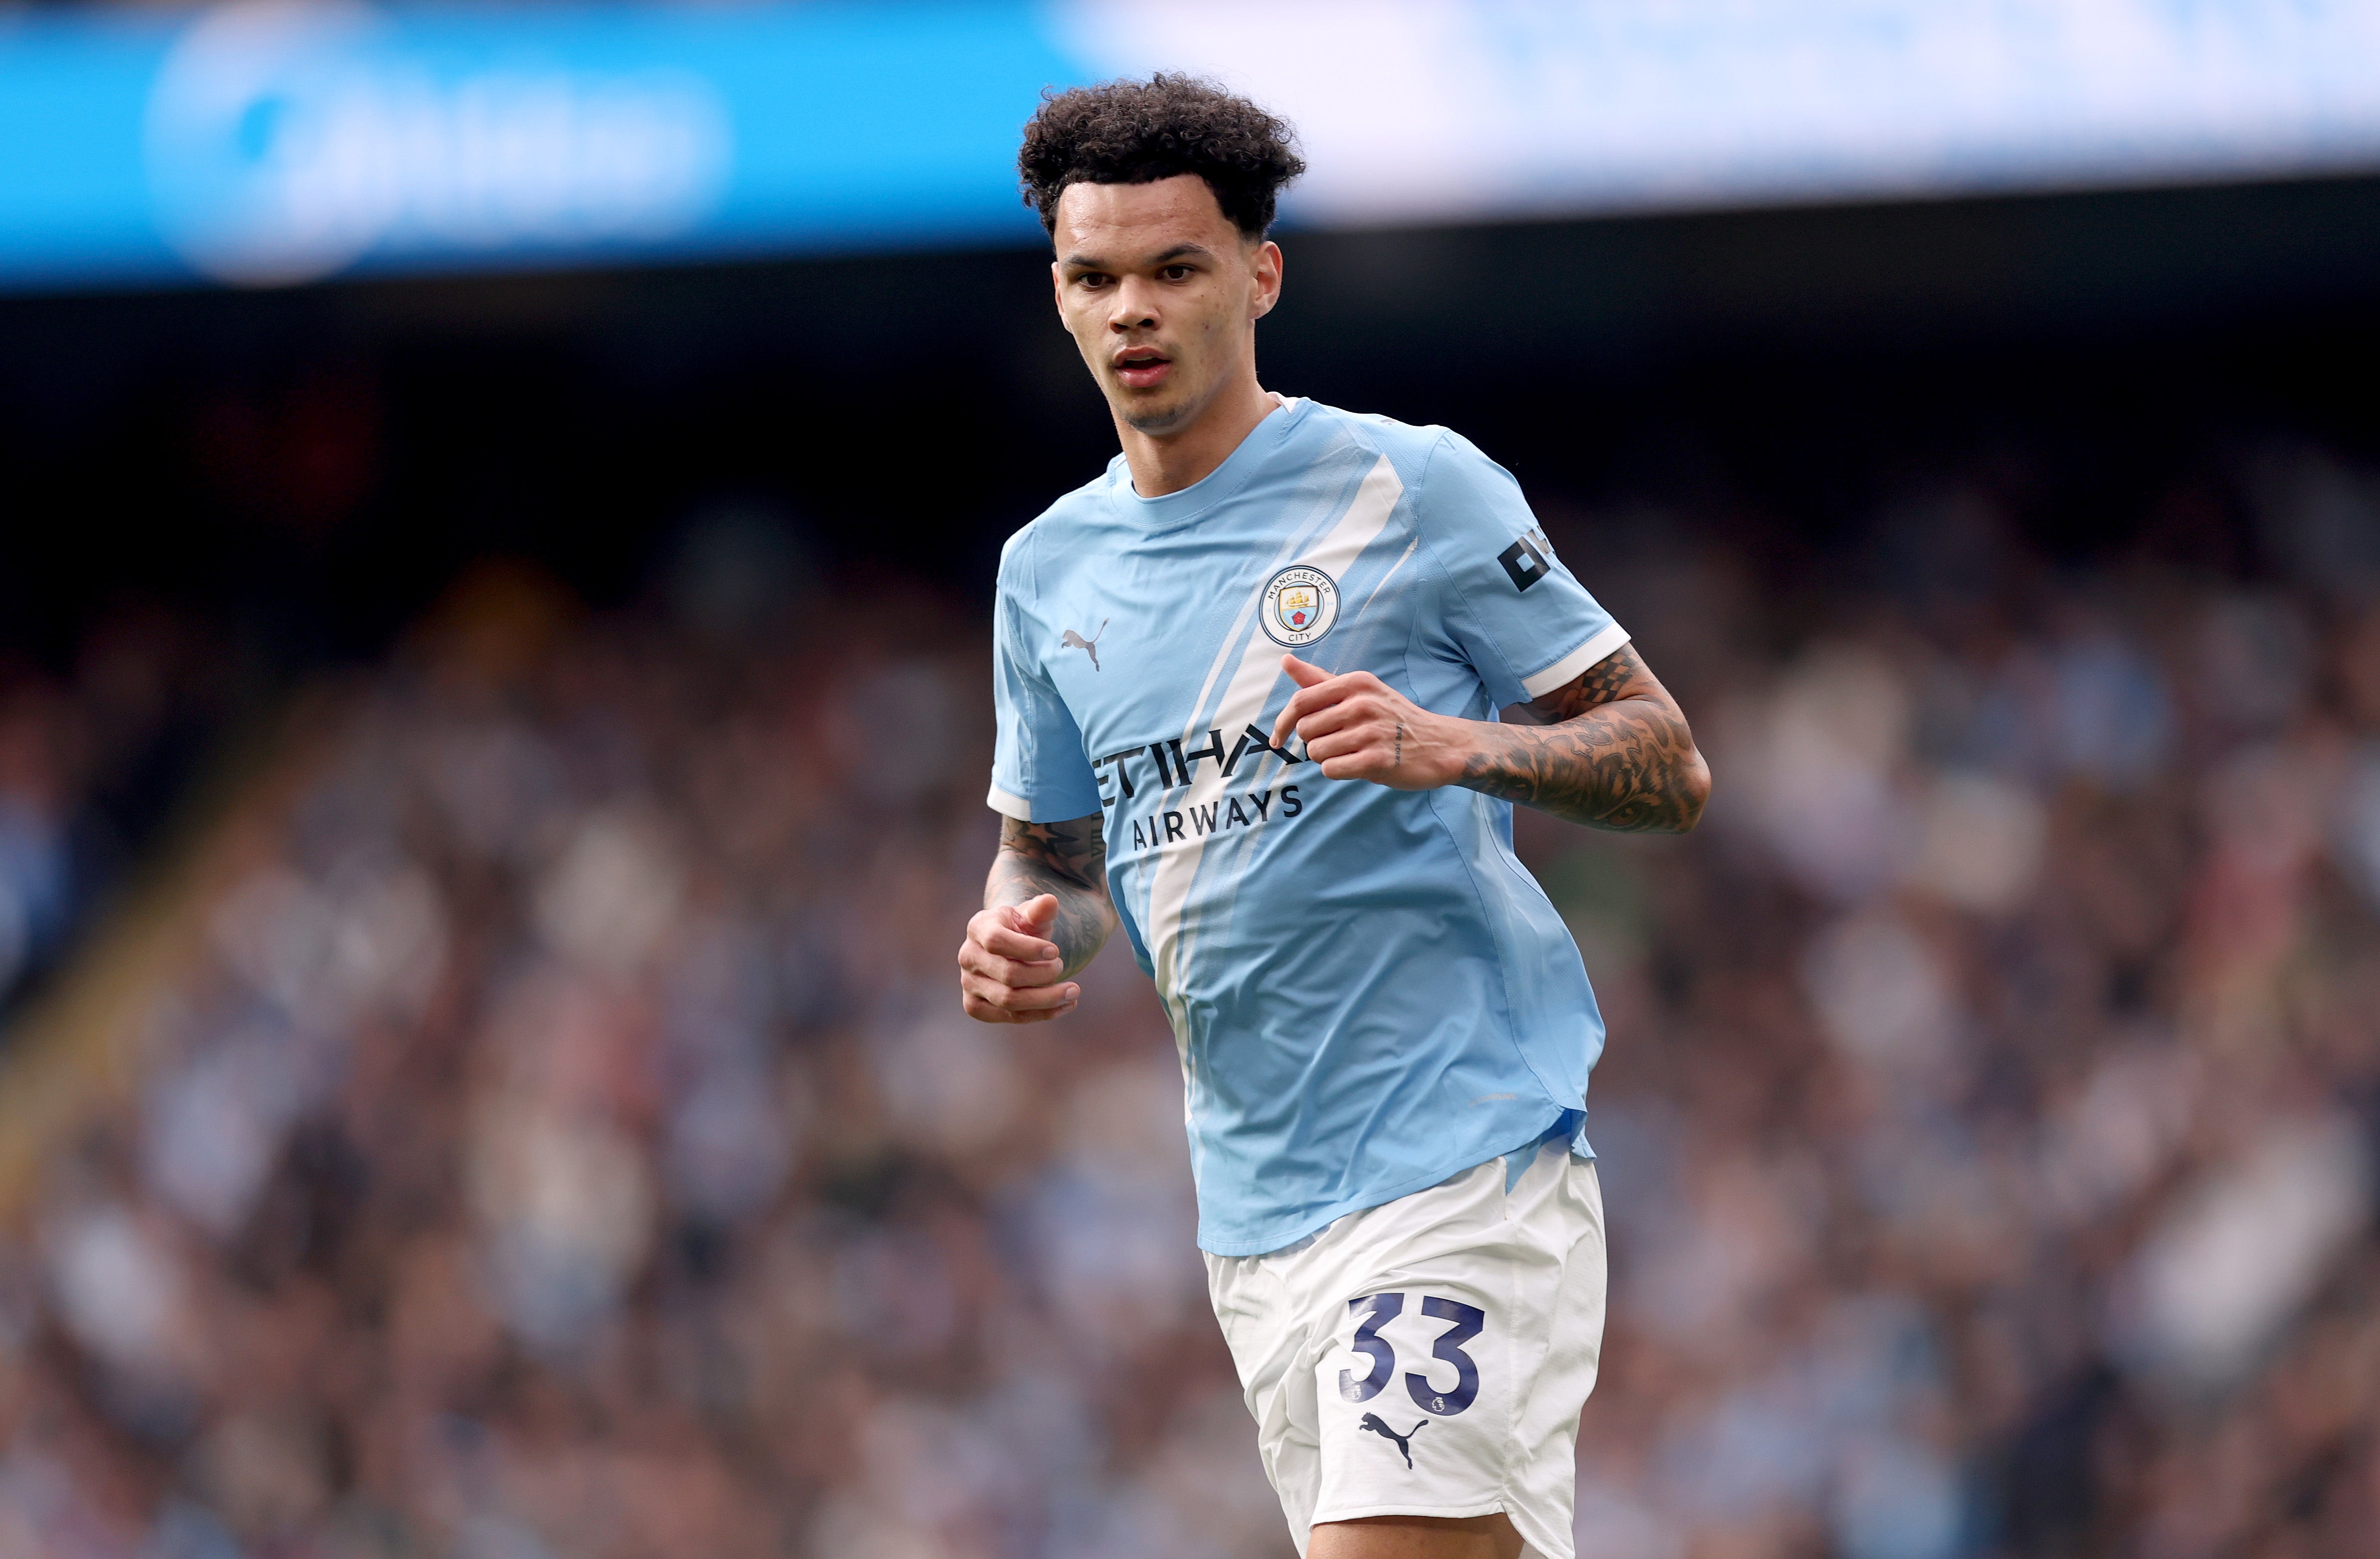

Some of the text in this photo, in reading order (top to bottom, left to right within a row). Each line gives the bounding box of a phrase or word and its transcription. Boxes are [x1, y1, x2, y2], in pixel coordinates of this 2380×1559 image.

[1268, 572, 1331, 599] MANCHESTER
[1288, 633, 1311, 642] CITY
[1092, 723, 1312, 808] ETIHA
[1133, 785, 1303, 851] AIRWAYS
[1339, 1292, 1485, 1416] 33
